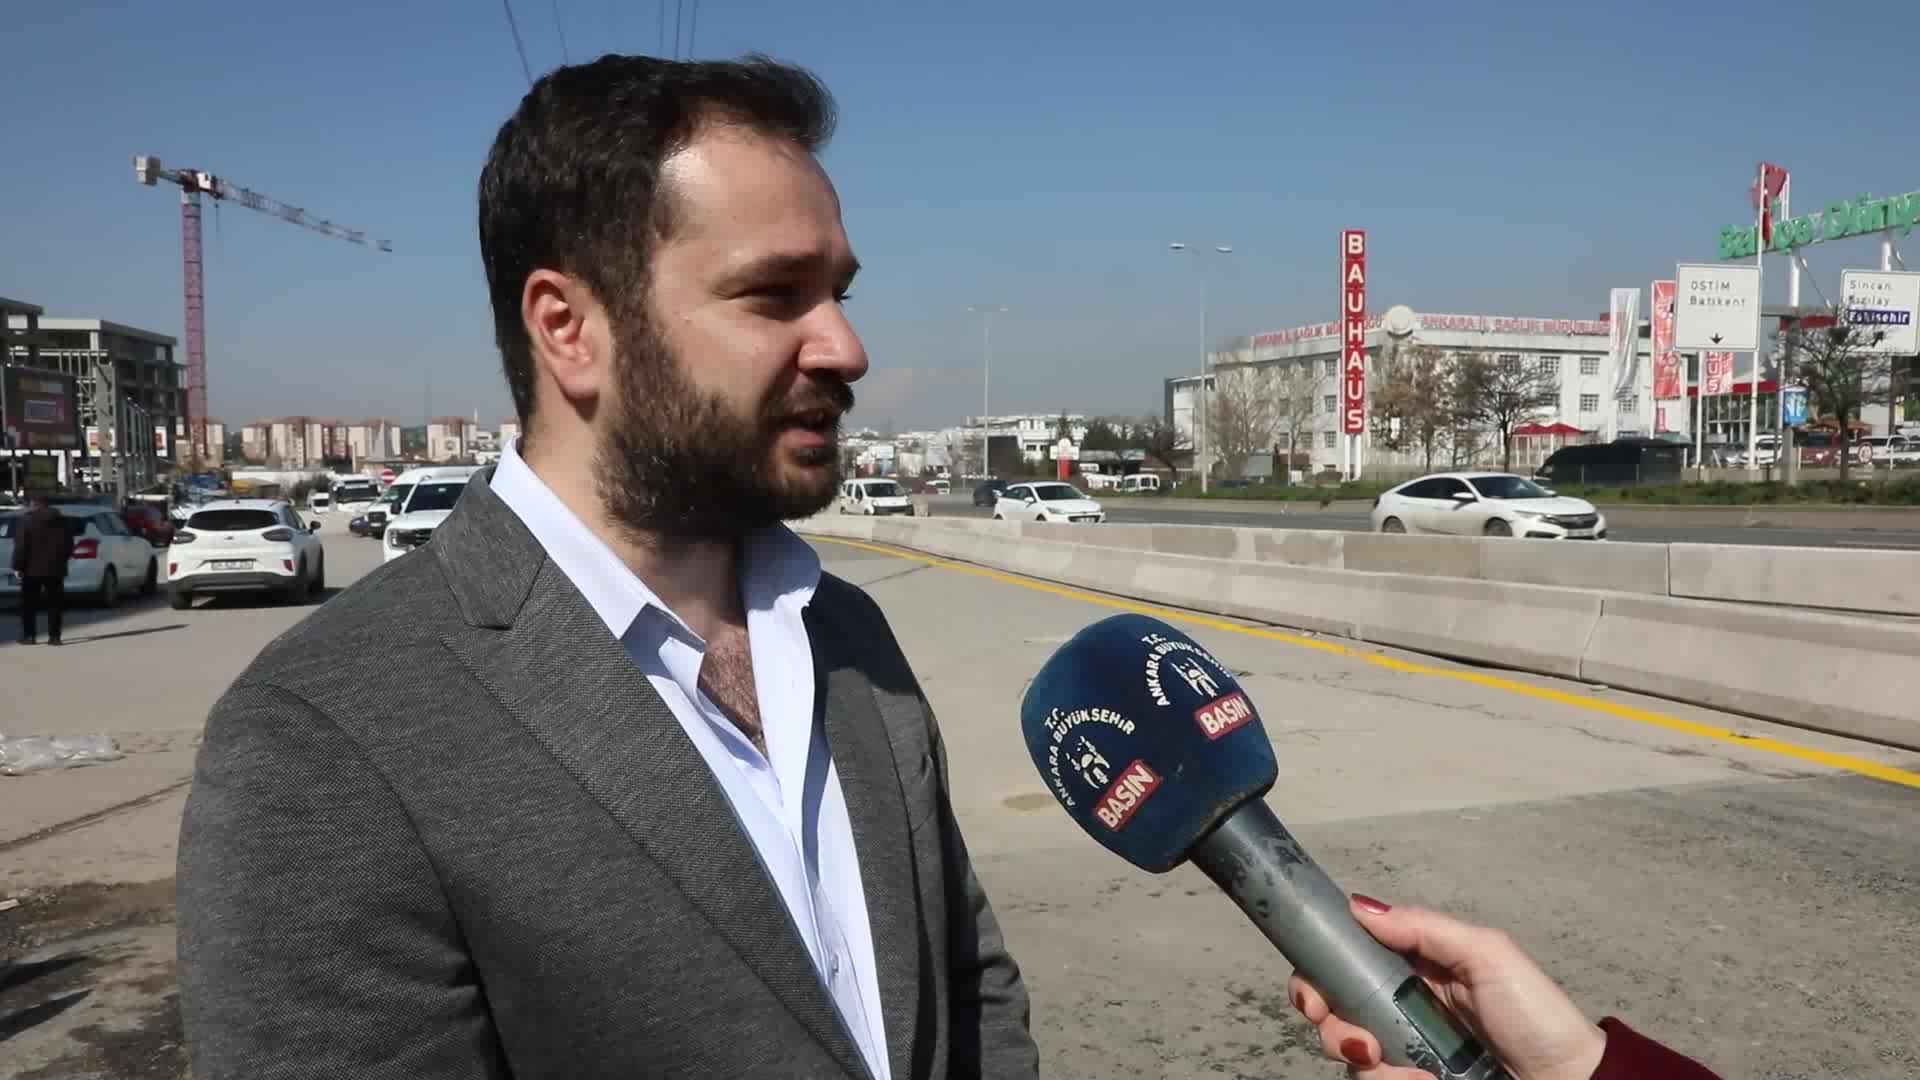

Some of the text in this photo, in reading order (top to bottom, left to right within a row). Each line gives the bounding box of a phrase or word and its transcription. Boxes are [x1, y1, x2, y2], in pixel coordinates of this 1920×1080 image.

[1849, 279, 1891, 290] Sincan
[1346, 233, 1365, 430] BAUHAUS
[1145, 653, 1171, 706] ANKARA
[1199, 695, 1252, 735] BASIN
[1048, 745, 1076, 807] ANKARA
[1097, 764, 1154, 828] BASIN
